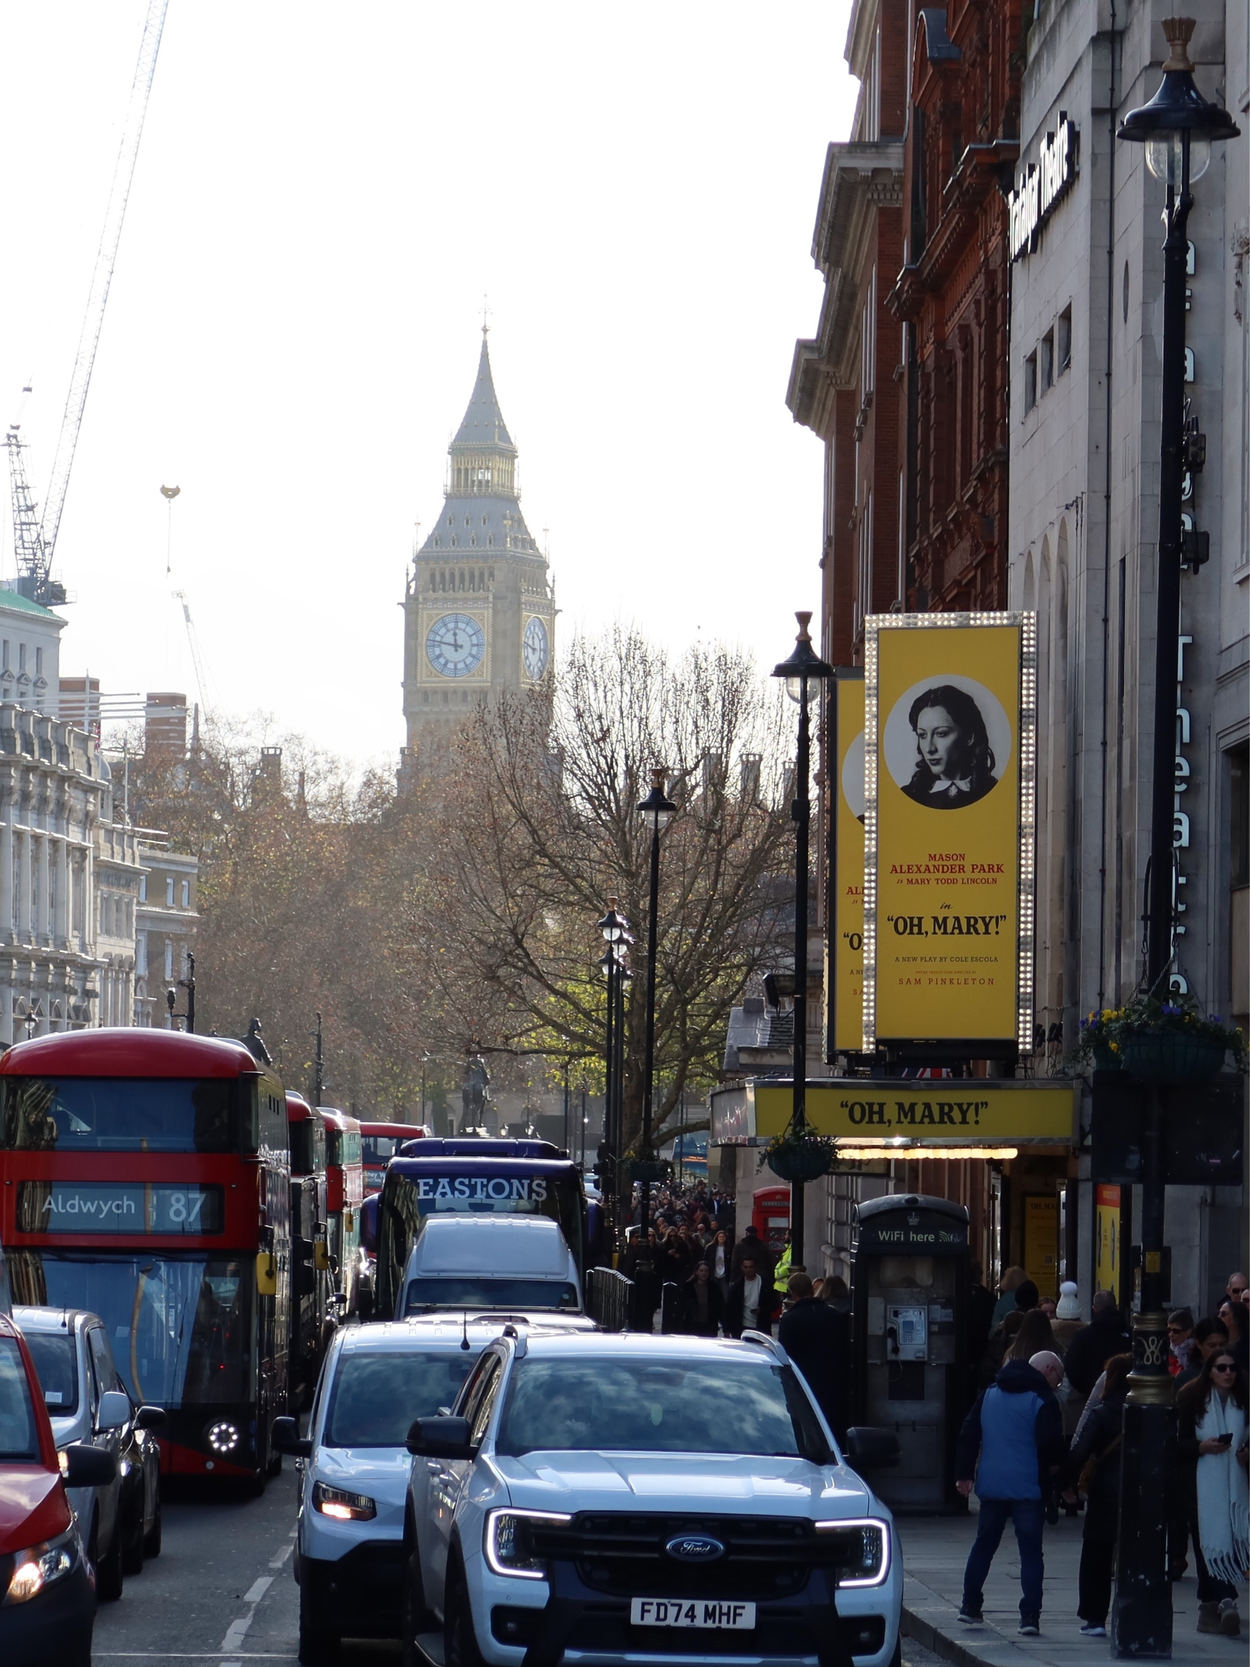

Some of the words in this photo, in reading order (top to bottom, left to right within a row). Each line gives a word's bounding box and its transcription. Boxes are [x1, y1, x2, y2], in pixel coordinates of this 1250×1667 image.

[928, 853, 966, 862] MASON
[889, 863, 966, 875] ALEXANDER
[970, 863, 1005, 874] PARK
[934, 877, 958, 885] TODD
[961, 877, 998, 885] LINCOLN
[939, 902, 953, 910] in
[887, 914, 929, 938] “OH,
[931, 914, 1007, 936] MARY!”
[898, 978, 922, 986] SAM
[928, 977, 995, 986] PINKLETON
[839, 1100, 892, 1128] “OH,
[894, 1100, 989, 1126] MARY!”
[416, 1177, 548, 1202] EASTONS
[41, 1194, 136, 1219] Aldwych
[168, 1192, 207, 1223] 87
[878, 1230, 904, 1242] WiFi
[909, 1230, 935, 1242] here
[679, 1540, 711, 1555] Ford
[640, 1601, 697, 1624] FD74
[703, 1603, 746, 1626] MHF
